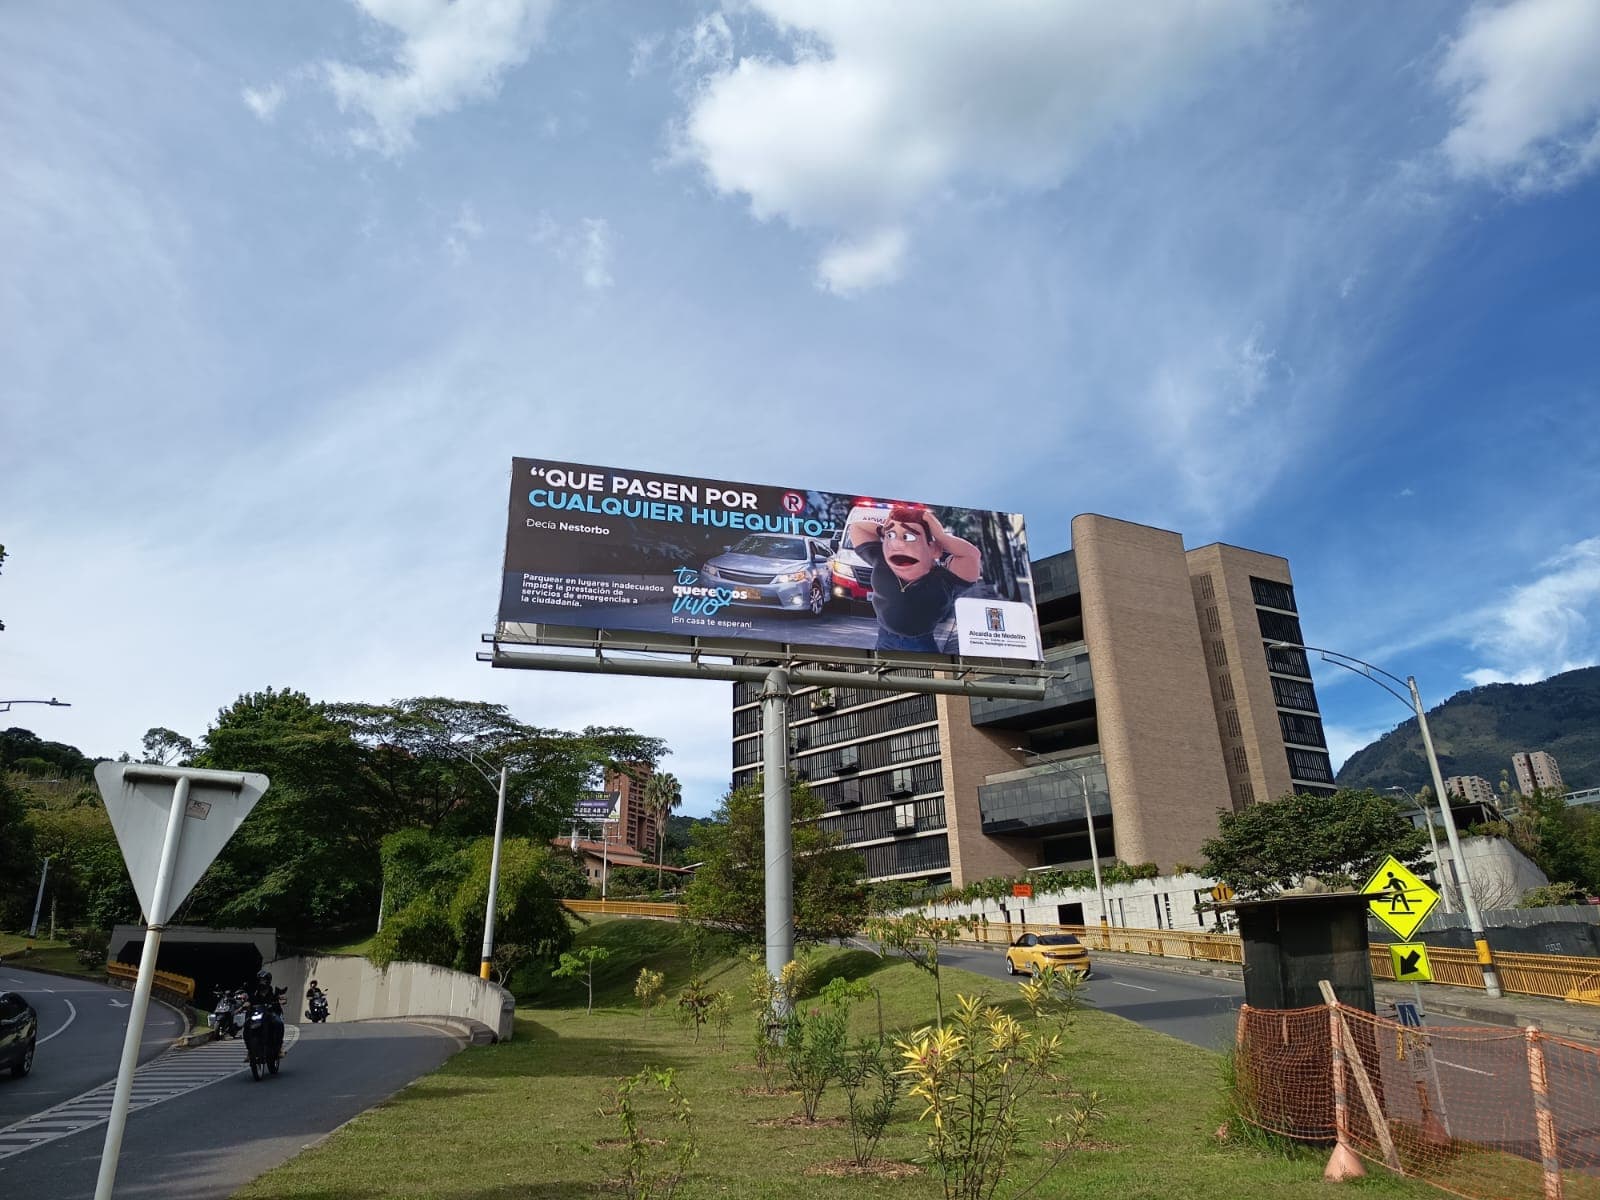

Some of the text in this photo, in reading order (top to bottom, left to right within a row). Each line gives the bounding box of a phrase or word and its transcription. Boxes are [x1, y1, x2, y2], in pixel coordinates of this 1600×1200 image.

[612, 476, 698, 503] PASEN
[705, 488, 758, 510] POR
[528, 488, 684, 523] CUALQUIER
[526, 518, 610, 535] Decía Nestorbo
[523, 573, 665, 592] Parquear en lugares inadecuados
[672, 566, 698, 585] te
[522, 588, 561, 598] servicios
[563, 591, 575, 599] de
[577, 594, 631, 604] emergencias
[555, 583, 564, 591] la
[566, 584, 611, 595] prestación
[613, 588, 624, 596] de
[531, 595, 583, 607] ciudadanía.
[686, 616, 705, 625] casa
[707, 618, 716, 626] te
[717, 620, 753, 628] esperan!
